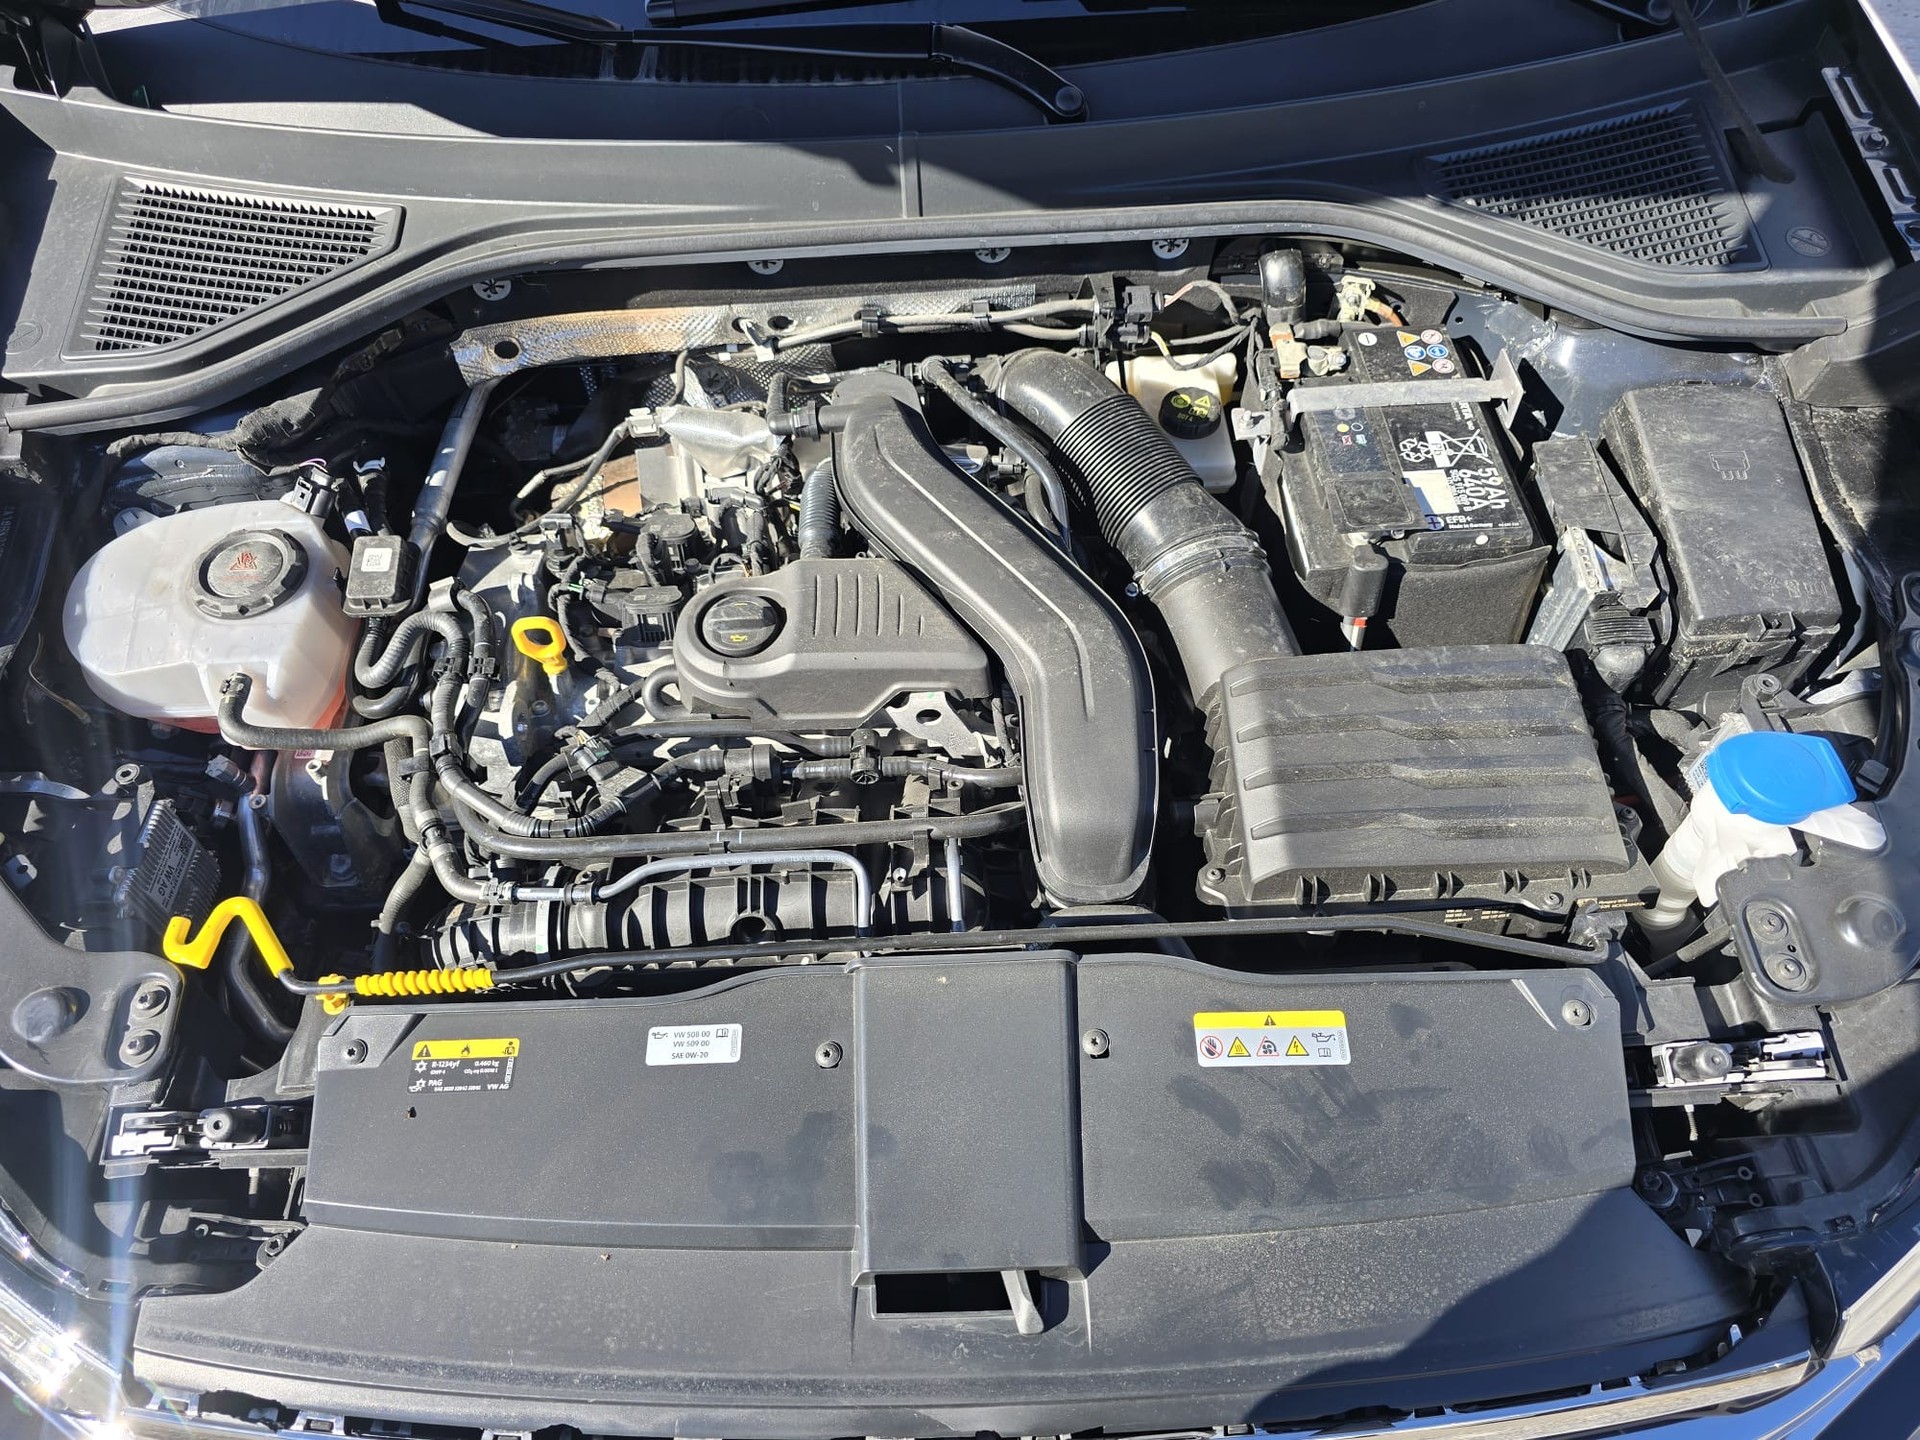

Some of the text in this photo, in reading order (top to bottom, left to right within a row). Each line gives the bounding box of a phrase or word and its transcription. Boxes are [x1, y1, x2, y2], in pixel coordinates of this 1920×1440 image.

[1431, 442, 1442, 456] Pb
[1459, 468, 1492, 510] 640A
[1478, 467, 1510, 509] 59Ah
[701, 1030, 711, 1038] 00
[431, 1060, 460, 1069] R-1234yf
